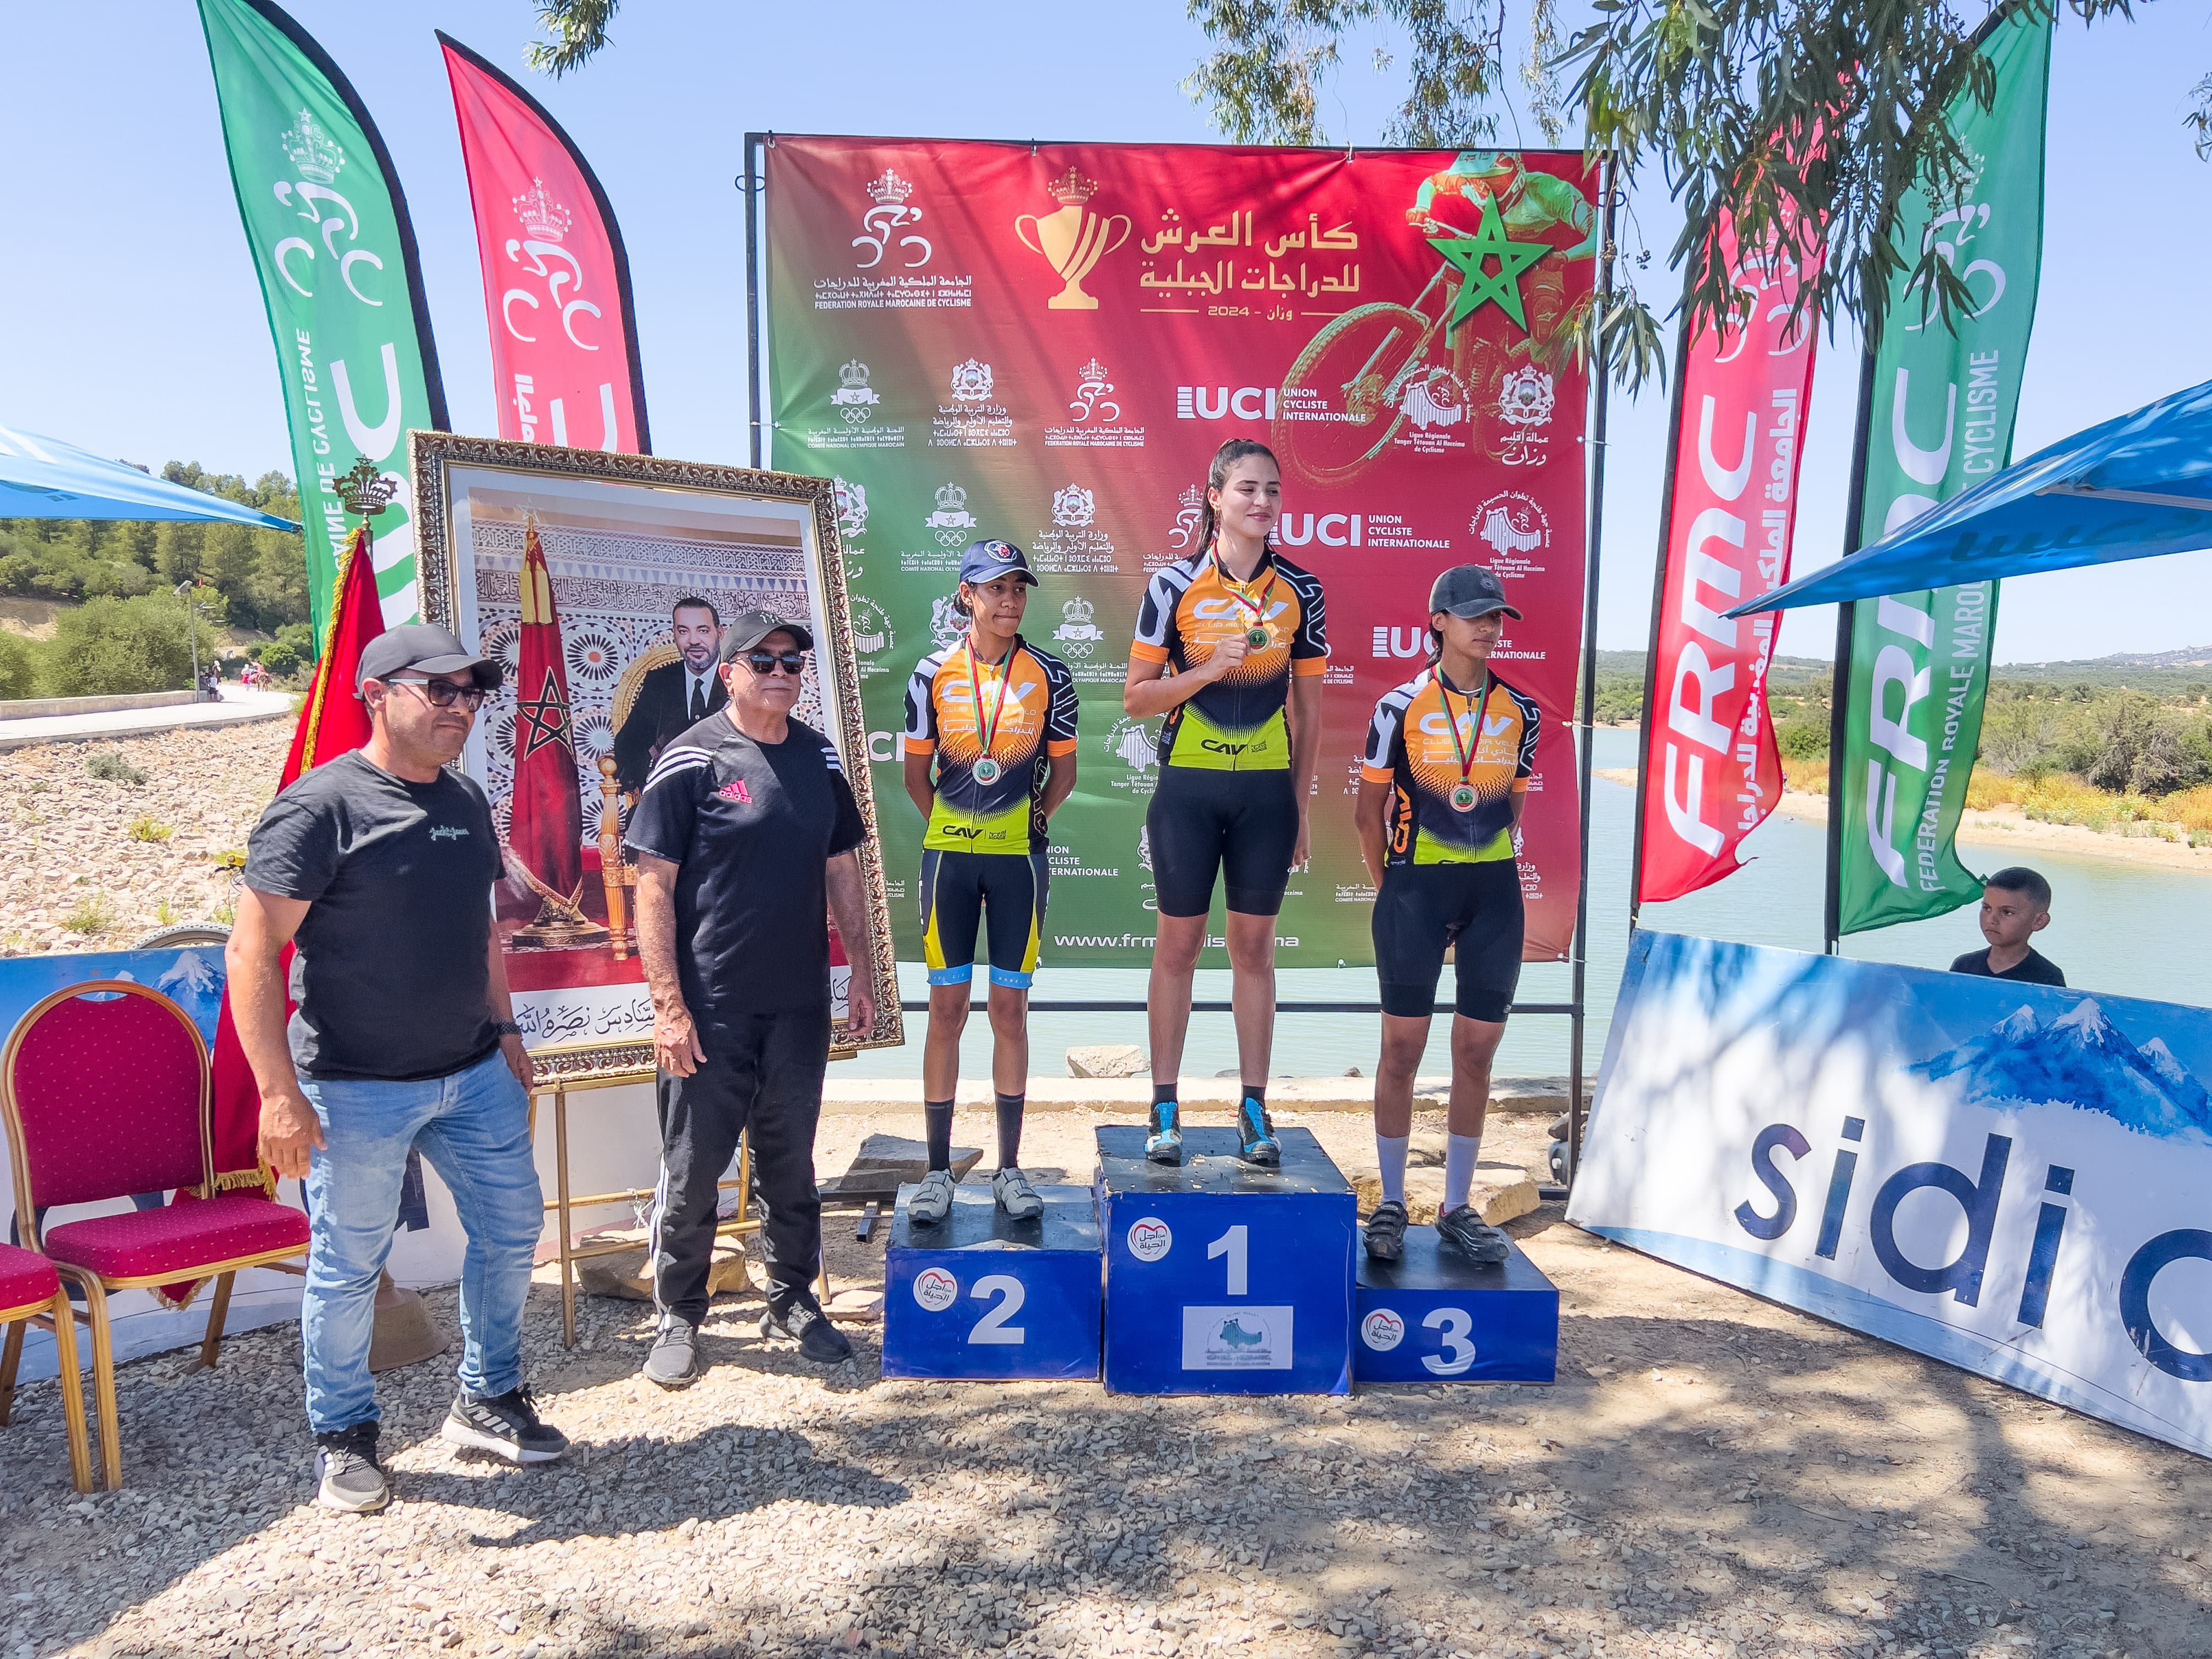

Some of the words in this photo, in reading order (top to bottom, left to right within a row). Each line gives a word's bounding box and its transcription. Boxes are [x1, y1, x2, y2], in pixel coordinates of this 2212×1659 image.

[1141, 208, 1252, 254] العرش
[1264, 212, 1358, 258] كأس
[814, 276, 860, 291] للدراجات
[862, 276, 896, 291] المغربية
[899, 275, 937, 287] الملكية
[939, 275, 972, 287] الجامعة
[1140, 259, 1233, 298] الجبلية
[1241, 261, 1359, 298] للدراجات
[815, 300, 856, 309] FEDERATION
[858, 300, 884, 308] ROYALE
[885, 299, 926, 308] MAROCAINE
[938, 298, 972, 307] CYCLISME
[1207, 306, 1249, 317] 2024
[1267, 304, 1293, 321] وزان
[1283, 388, 1317, 397] UNION
[987, 404, 1007, 415] وزارة
[1283, 400, 1328, 409] CYCLISTE
[1283, 413, 1366, 422] INTERNATIONALE
[1368, 515, 1402, 524] UNION
[1039, 530, 1063, 541] الوطنية
[1064, 530, 1086, 541] التربية
[1088, 531, 1108, 541] وزارة
[1368, 527, 1412, 536] CYCLISTE
[1088, 542, 1114, 554] والتعليم
[1368, 539, 1450, 549] INTERNATIONALE
[1919, 760, 1949, 893] FEDERATION
[1942, 666, 1976, 750] ROYALE
[1963, 348, 1999, 472] CYCLISME
[1200, 739, 1249, 755] CAV
[1126, 774, 1142, 782] Ligue
[718, 789, 753, 804] adidas
[943, 825, 983, 839] CAV
[1734, 1115, 2075, 1329] sidi
[1139, 1239, 1165, 1250] الحياة
[1208, 1225, 1248, 1295] 1
[923, 1289, 950, 1302] الحياة
[968, 1274, 1025, 1345] 2
[1421, 1307, 1476, 1375] 3
